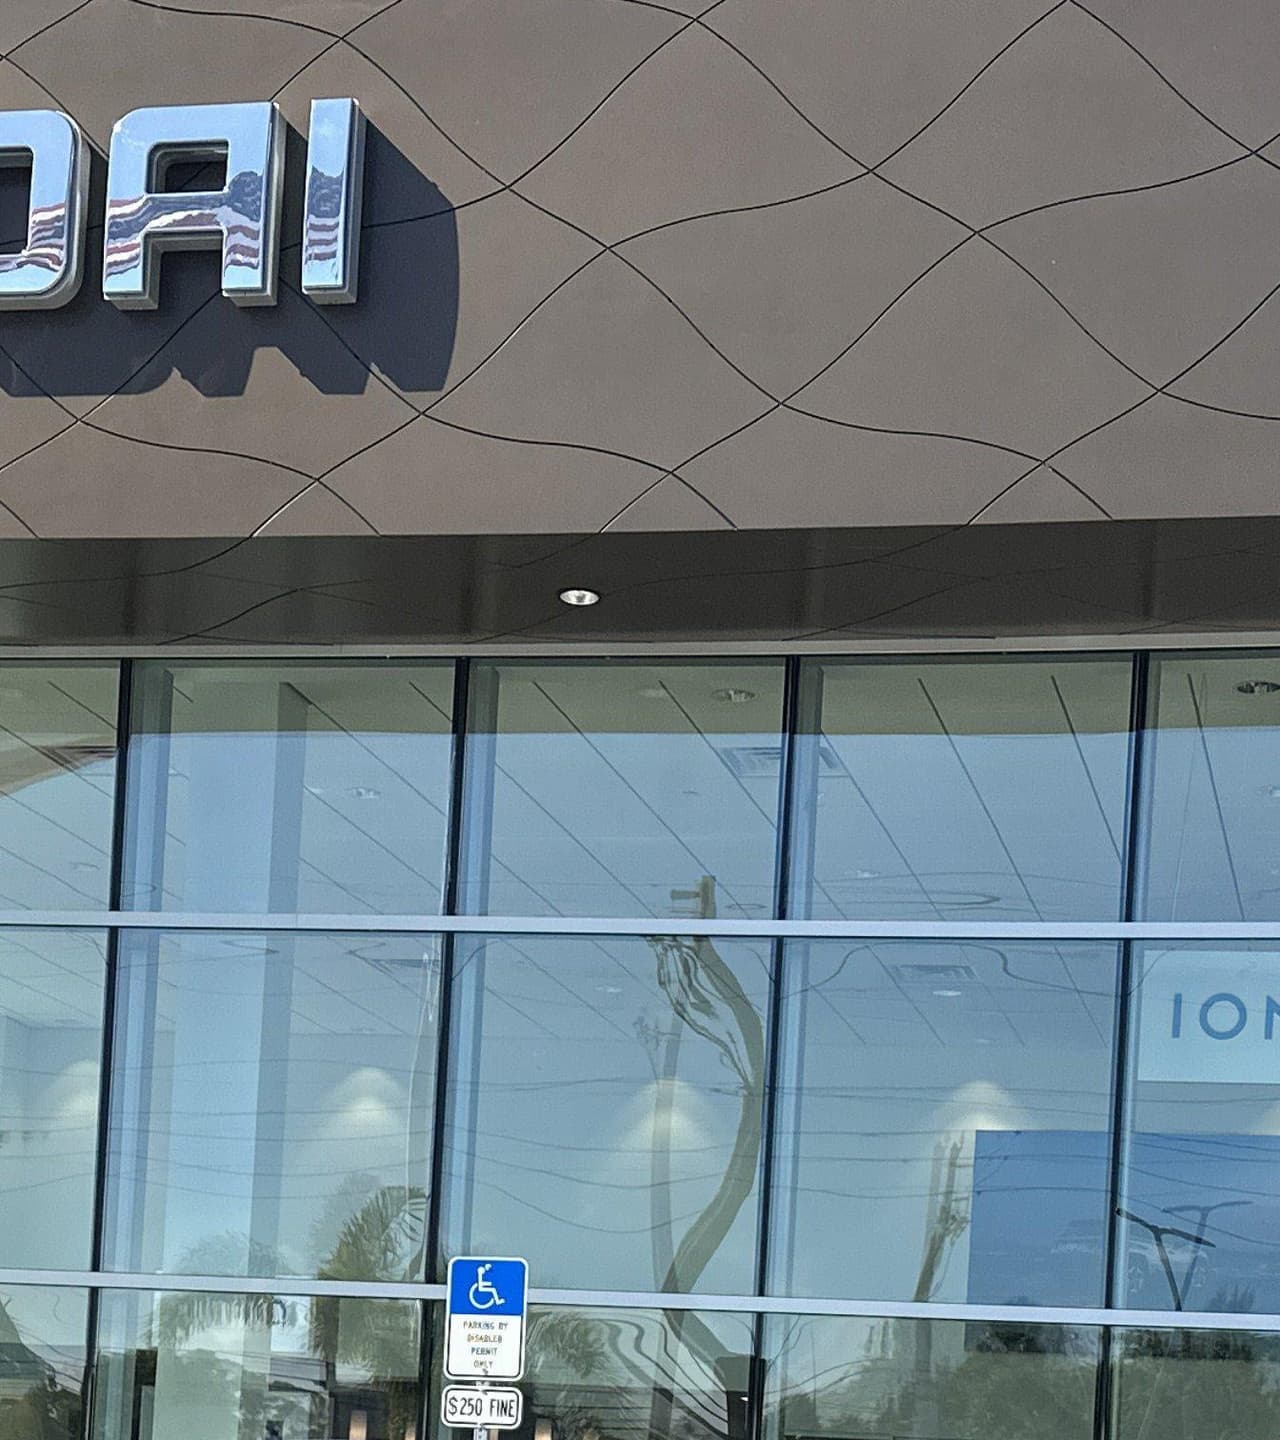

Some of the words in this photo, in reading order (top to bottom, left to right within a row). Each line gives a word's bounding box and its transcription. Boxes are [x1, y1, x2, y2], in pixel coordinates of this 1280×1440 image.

[463, 1321, 495, 1331] PARKING
[498, 1322, 509, 1331] BY
[467, 1334, 503, 1344] DISABLED
[471, 1347, 498, 1356] PERMIT
[474, 1361, 494, 1370] ONLY
[448, 1396, 483, 1417] $250
[489, 1398, 516, 1418] FINE
